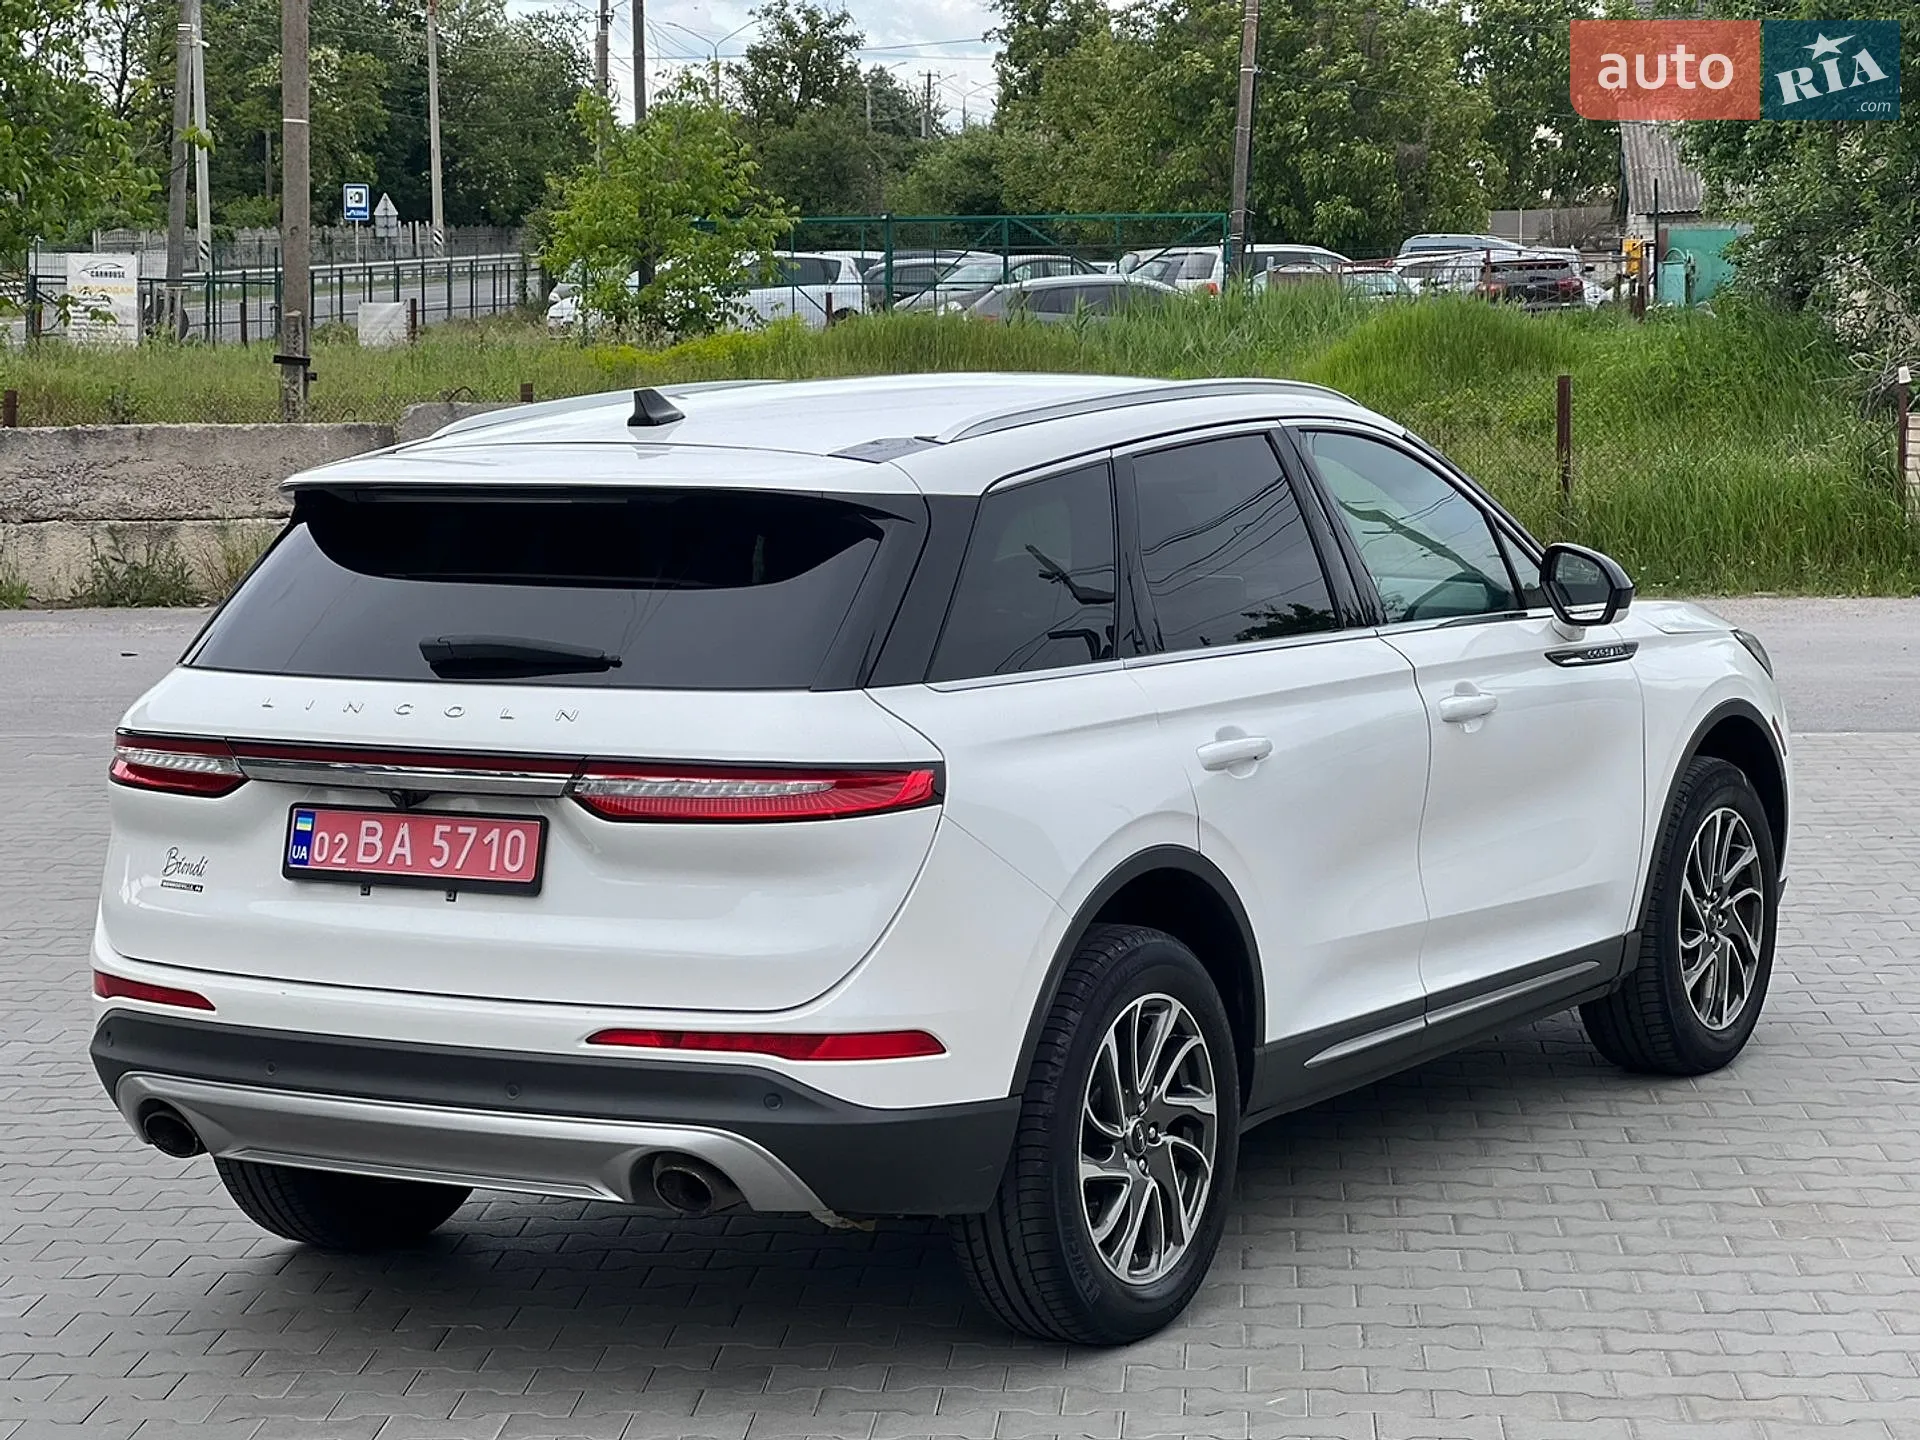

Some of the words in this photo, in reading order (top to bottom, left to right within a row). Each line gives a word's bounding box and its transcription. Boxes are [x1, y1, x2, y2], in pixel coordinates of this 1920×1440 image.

[262, 697, 580, 722] LINCOLN
[161, 846, 209, 877] Biondi
[292, 845, 308, 860] UA
[429, 824, 527, 873] 5710
